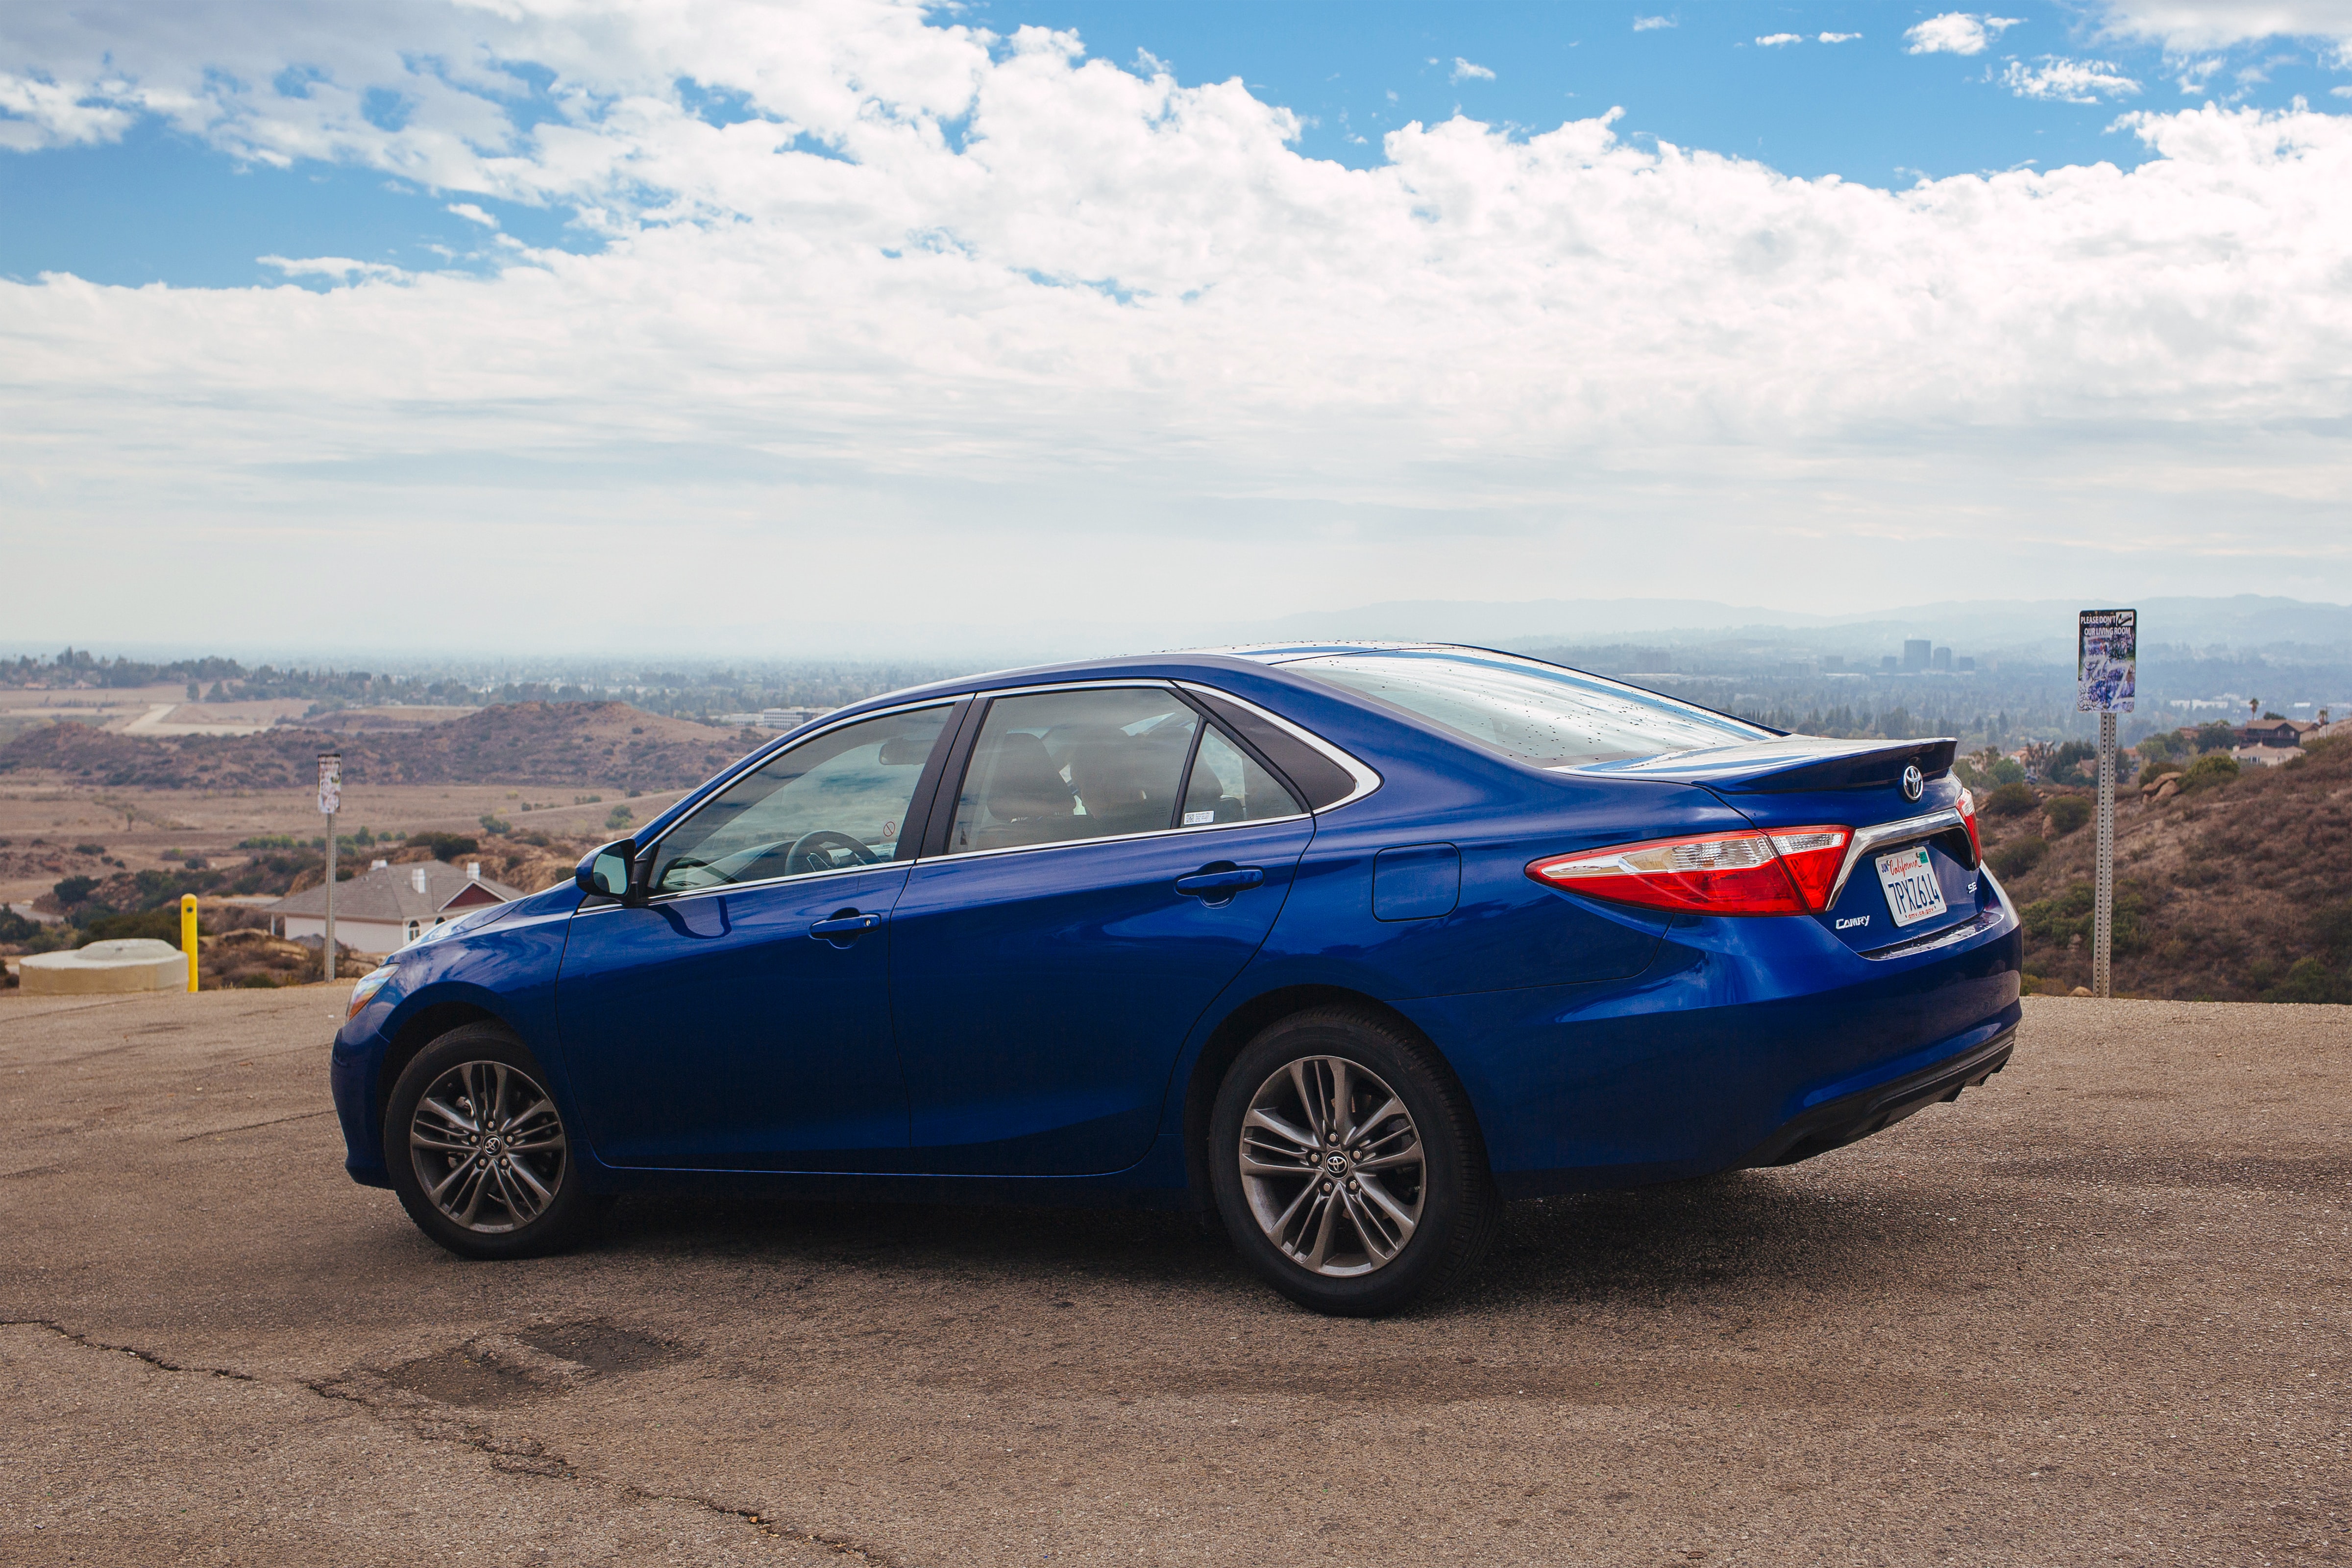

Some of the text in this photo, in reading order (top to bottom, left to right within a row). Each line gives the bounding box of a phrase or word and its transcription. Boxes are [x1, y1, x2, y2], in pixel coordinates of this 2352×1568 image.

[2081, 616, 2098, 624] PLEASE
[2099, 615, 2116, 624] DON'T
[1881, 863, 1889, 873] JUN
[1889, 857, 1922, 877] California
[1887, 874, 1940, 914] 7PXZ614
[1968, 882, 1977, 894] SE
[1909, 907, 1934, 919] dmv.ca.gov
[1836, 915, 1870, 930] CAMRY
